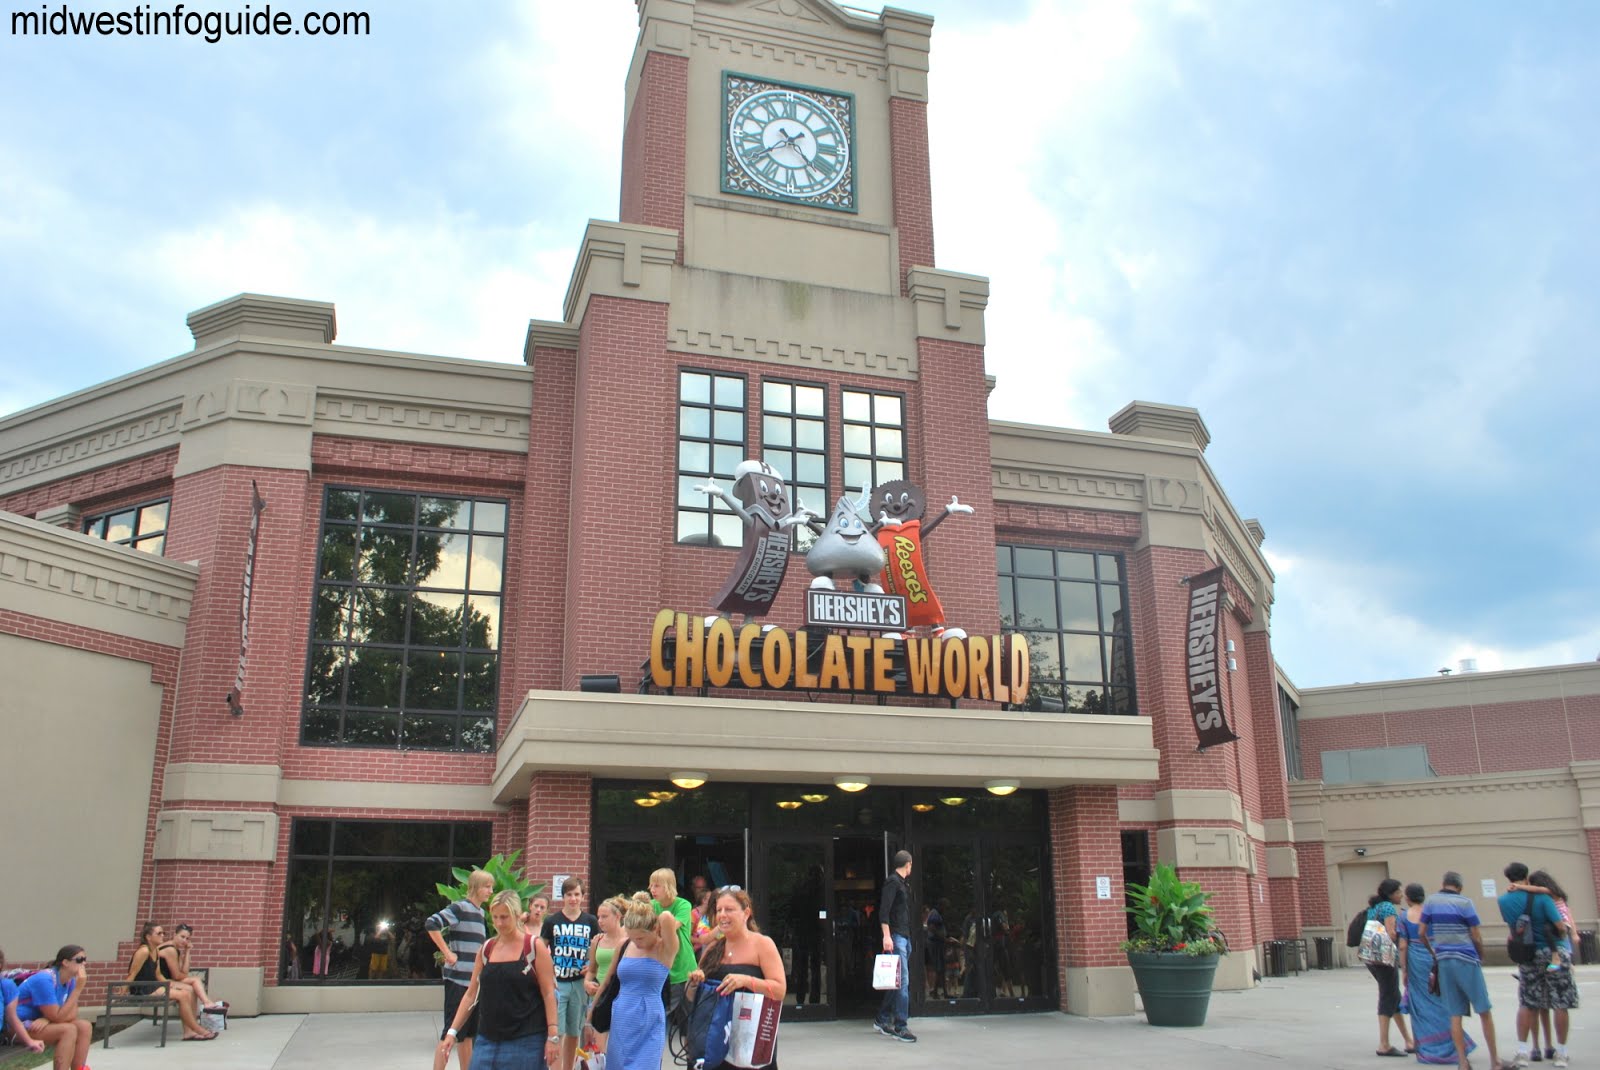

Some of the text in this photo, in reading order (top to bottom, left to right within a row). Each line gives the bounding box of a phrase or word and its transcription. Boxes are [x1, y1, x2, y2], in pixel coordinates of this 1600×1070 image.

[739, 557, 761, 592] CHOCOLATE
[744, 531, 788, 602] HERSHEY'S
[813, 594, 901, 625] HERSHEY'S
[649, 608, 897, 693] CHOCOLATE
[906, 632, 1031, 705] WORLD
[1188, 582, 1223, 732] HERSHEY'S
[554, 936, 590, 949] EAGLE
